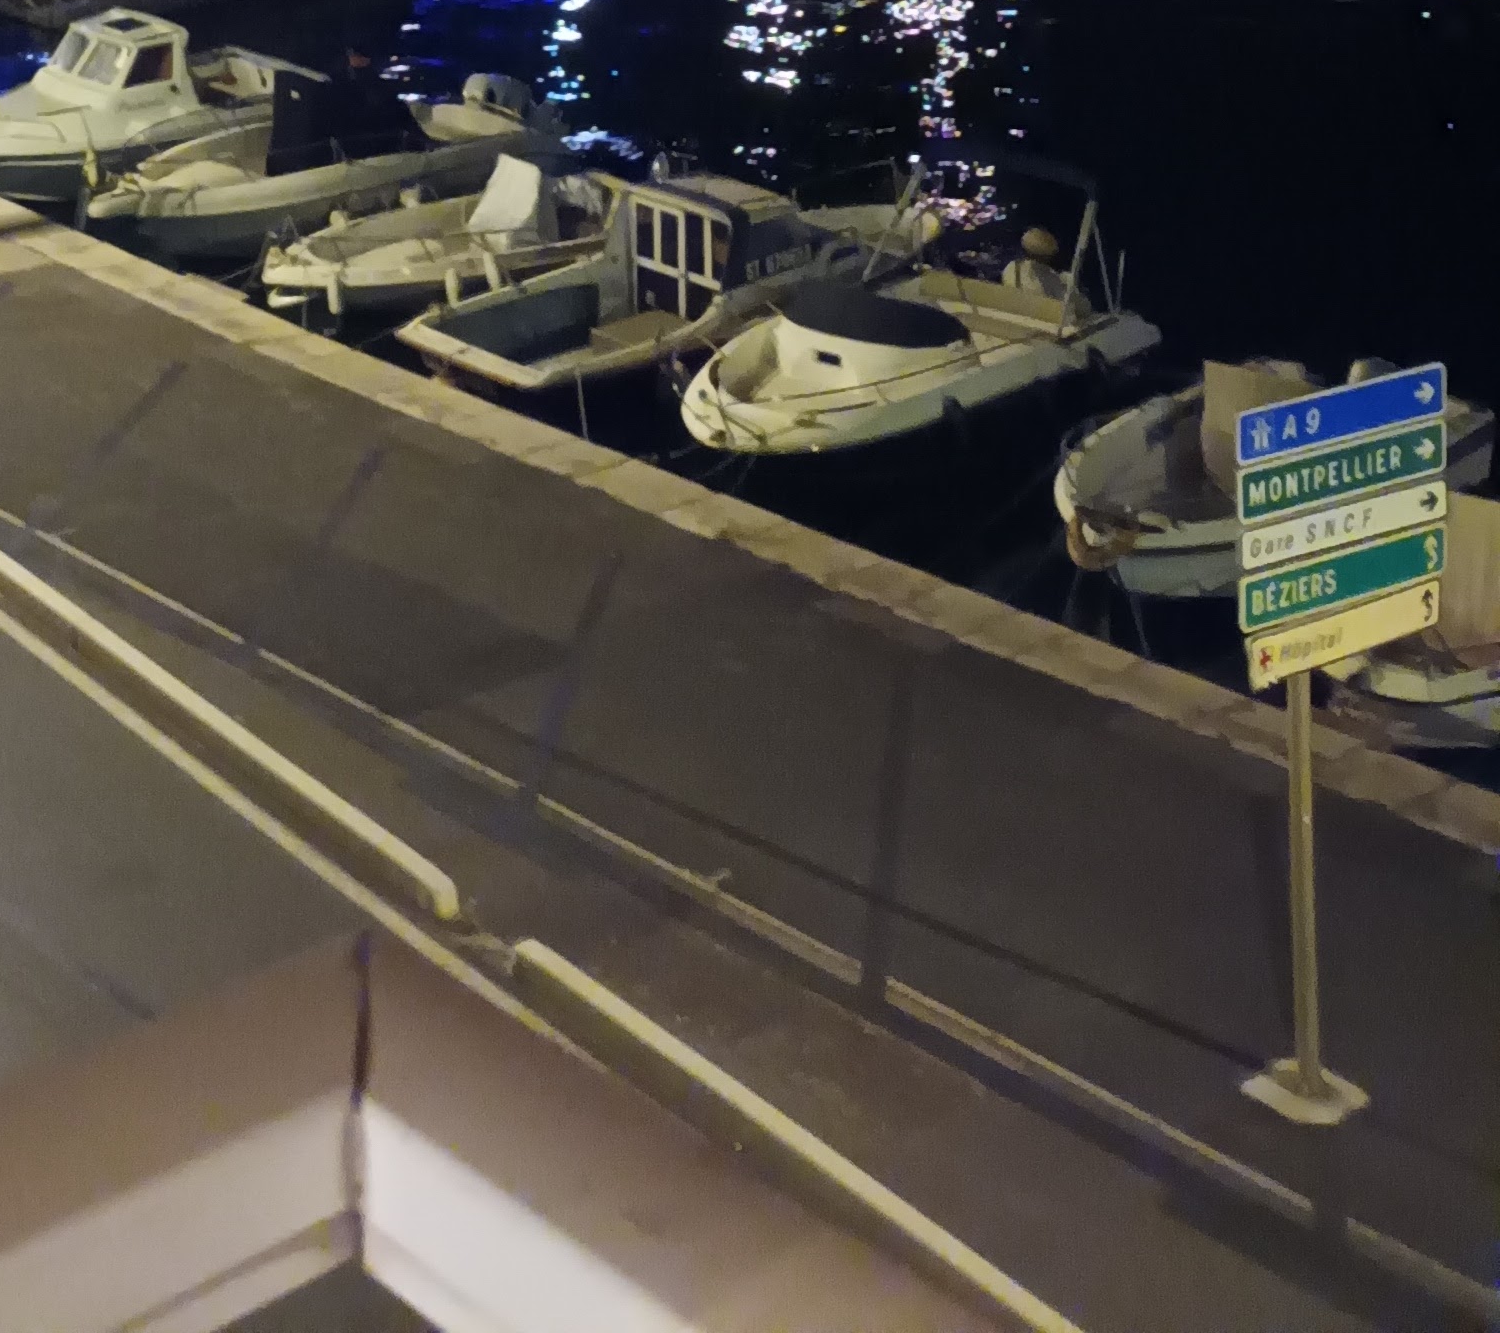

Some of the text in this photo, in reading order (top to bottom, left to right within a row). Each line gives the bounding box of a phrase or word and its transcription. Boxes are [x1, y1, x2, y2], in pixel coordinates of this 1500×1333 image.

[1248, 444, 1402, 508] MONTPELLIER
[1249, 533, 1295, 559] Gare
[1251, 568, 1338, 616] BÉZIERS
